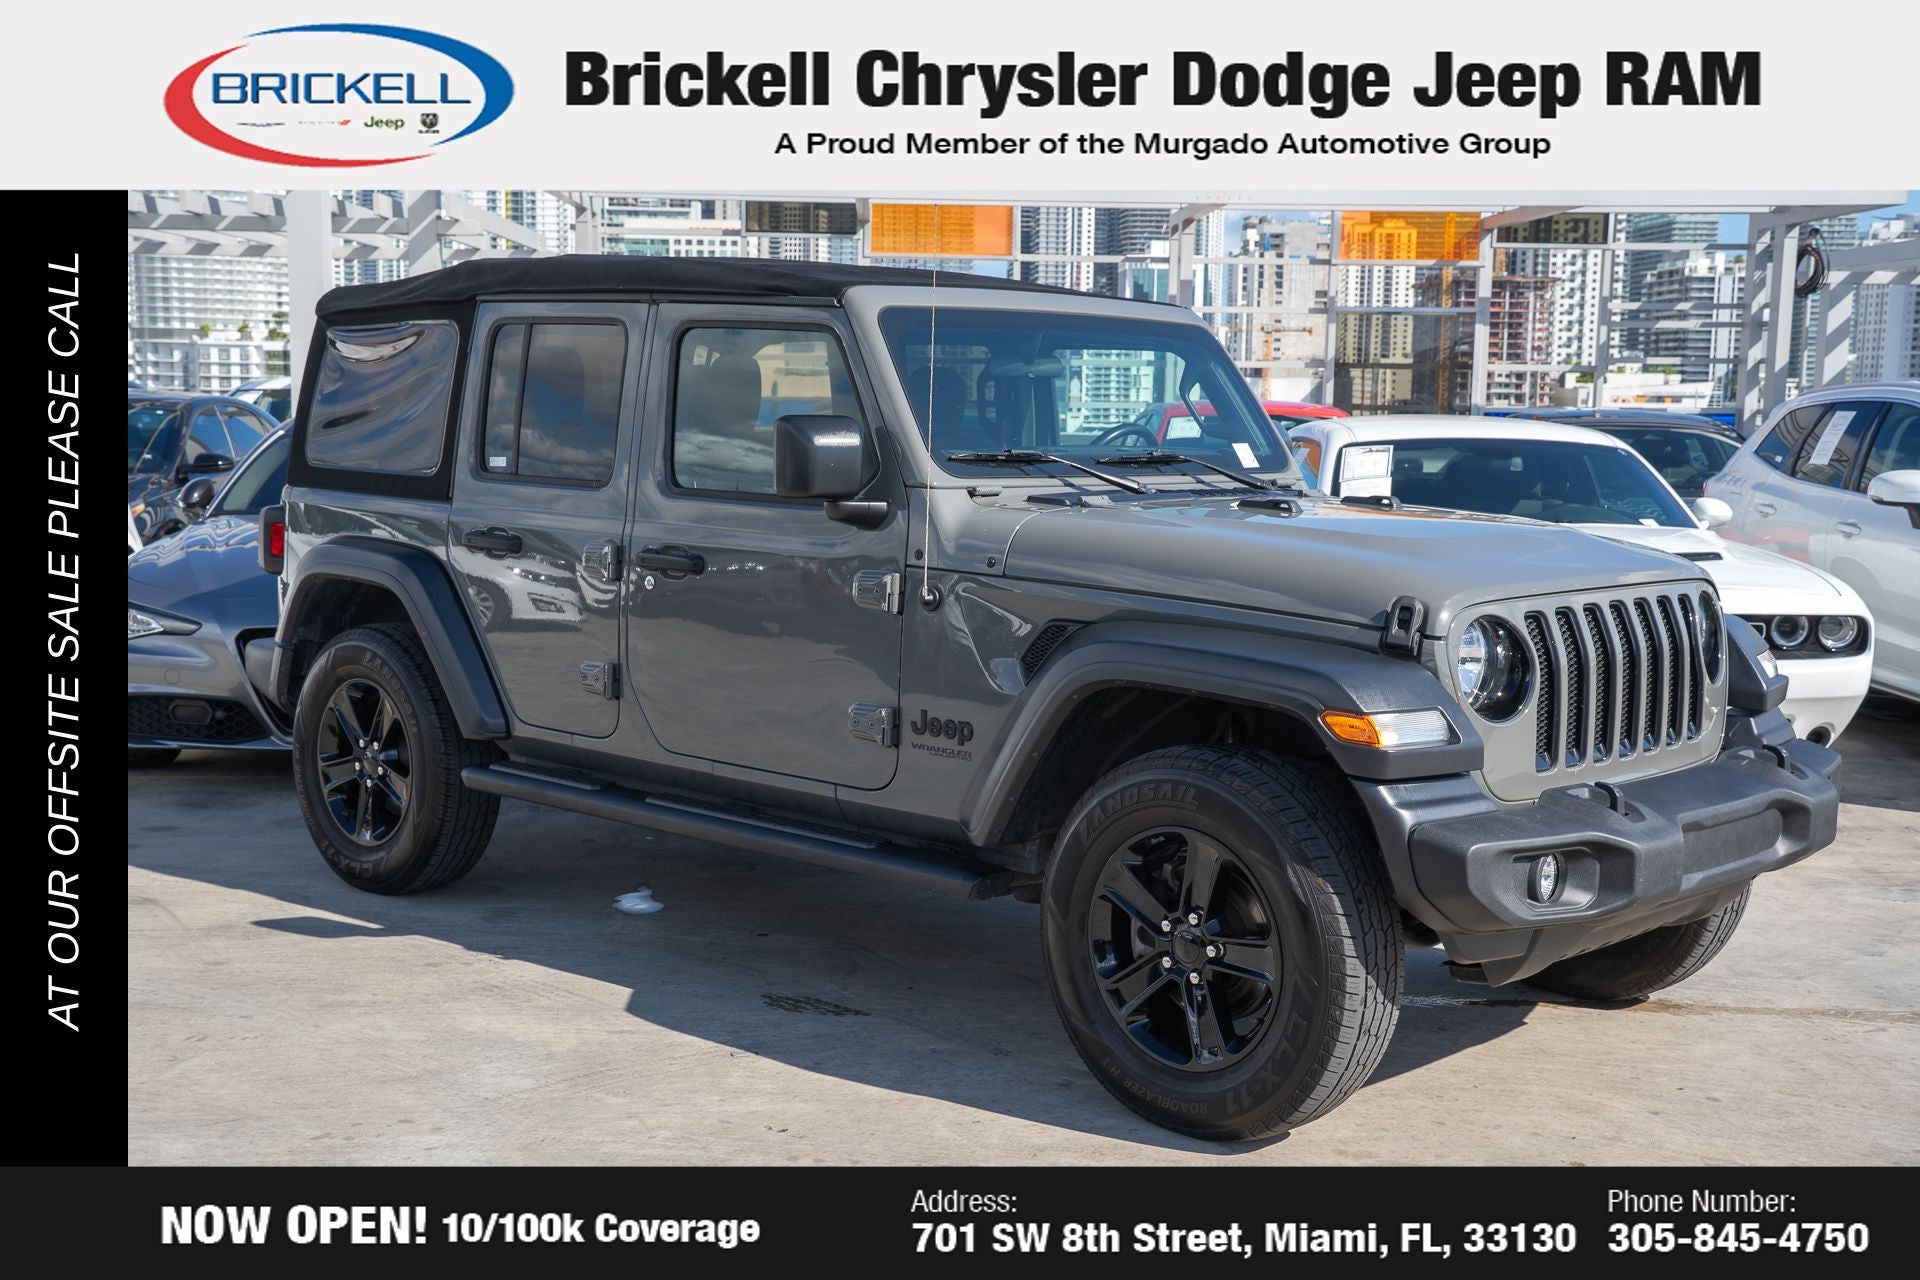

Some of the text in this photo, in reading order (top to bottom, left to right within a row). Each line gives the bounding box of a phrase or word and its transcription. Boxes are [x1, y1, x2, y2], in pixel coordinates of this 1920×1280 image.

[911, 709, 974, 746] Jeep
[910, 741, 972, 758] WRANGLER
[1077, 782, 1200, 848] LANDSAIL
[1123, 1076, 1208, 1114] ROADBLAZER
